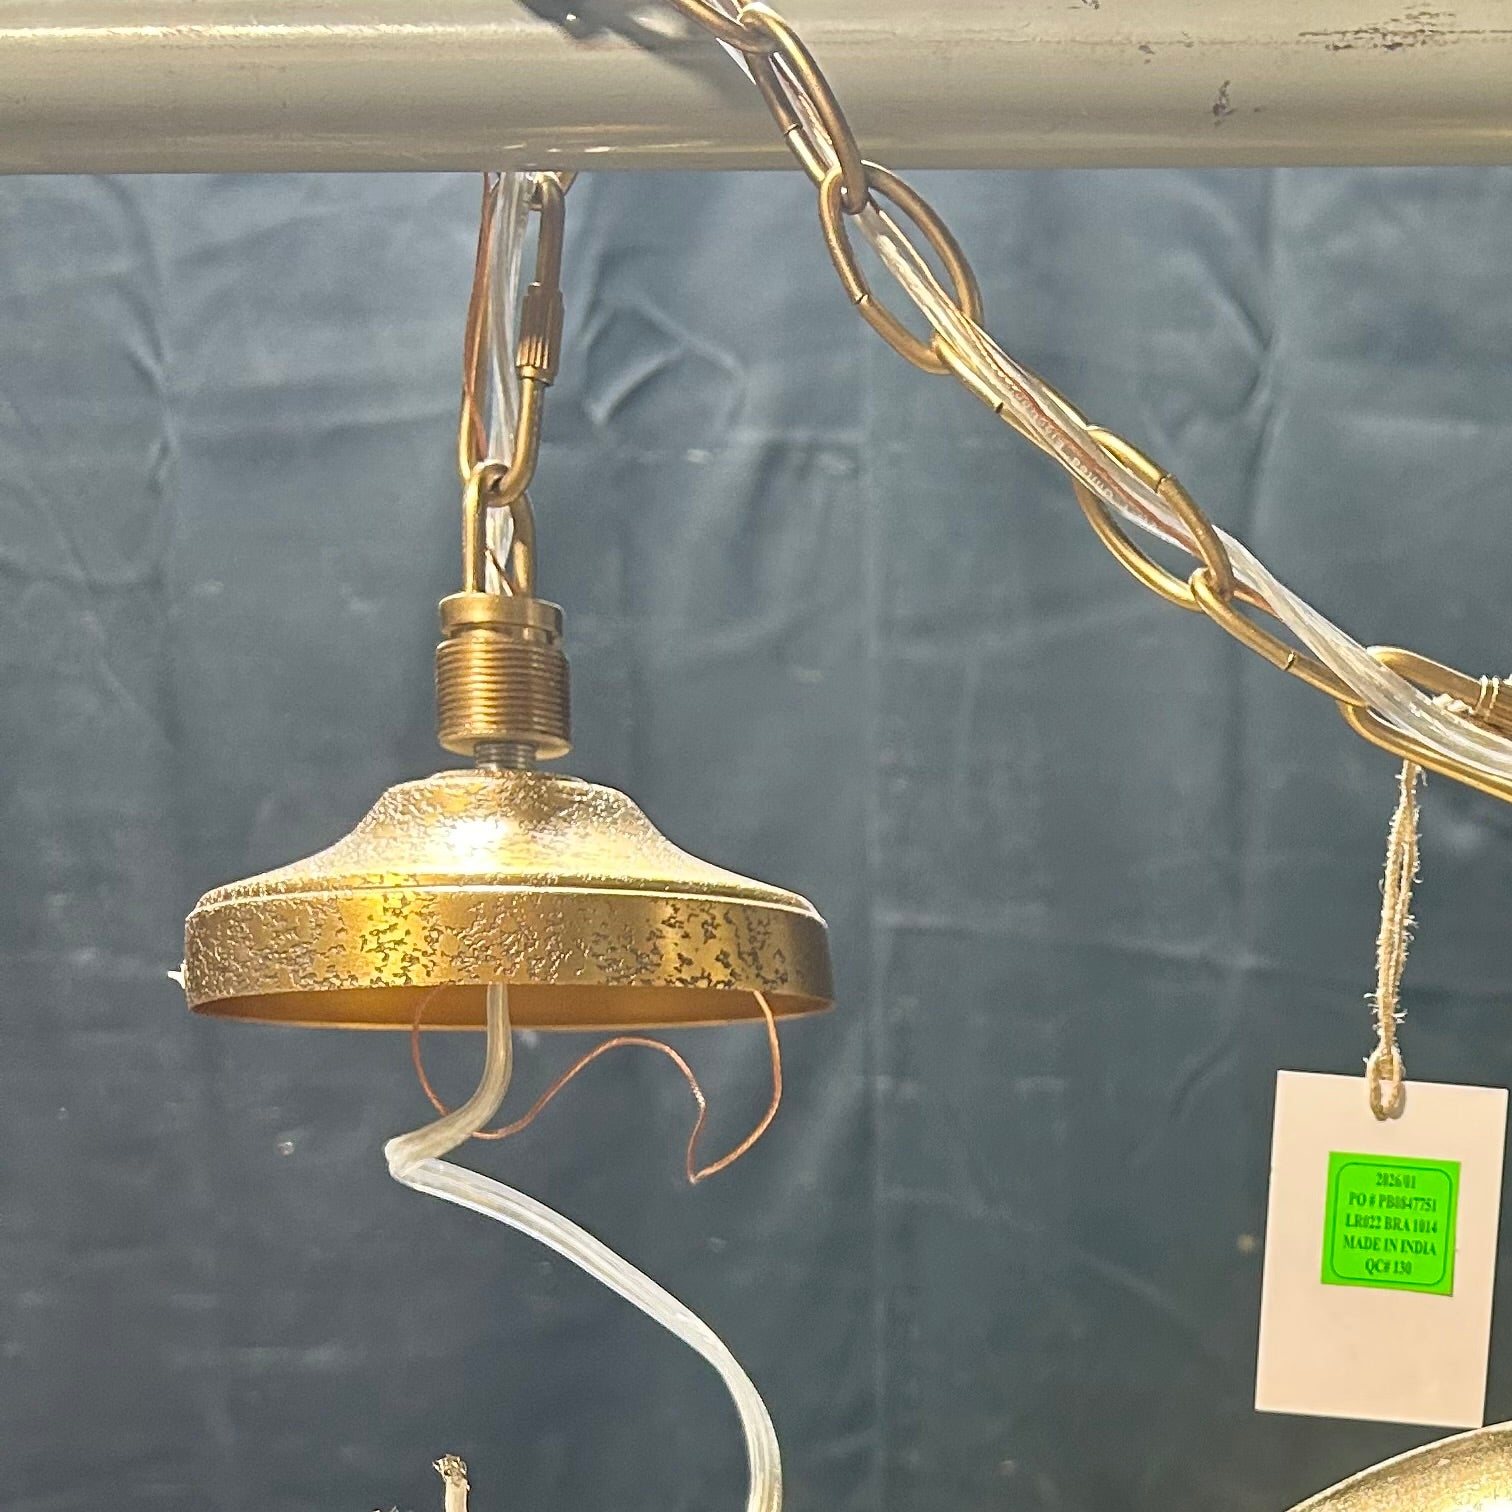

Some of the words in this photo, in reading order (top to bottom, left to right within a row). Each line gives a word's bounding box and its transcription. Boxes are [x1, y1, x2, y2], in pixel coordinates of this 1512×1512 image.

[1349, 1191, 1367, 1207] PO
[1369, 1194, 1376, 1207] #
[1385, 1216, 1410, 1232] BRA
[1343, 1234, 1381, 1251] MADE
[1384, 1237, 1399, 1253] IN
[1400, 1239, 1437, 1256] INDIA
